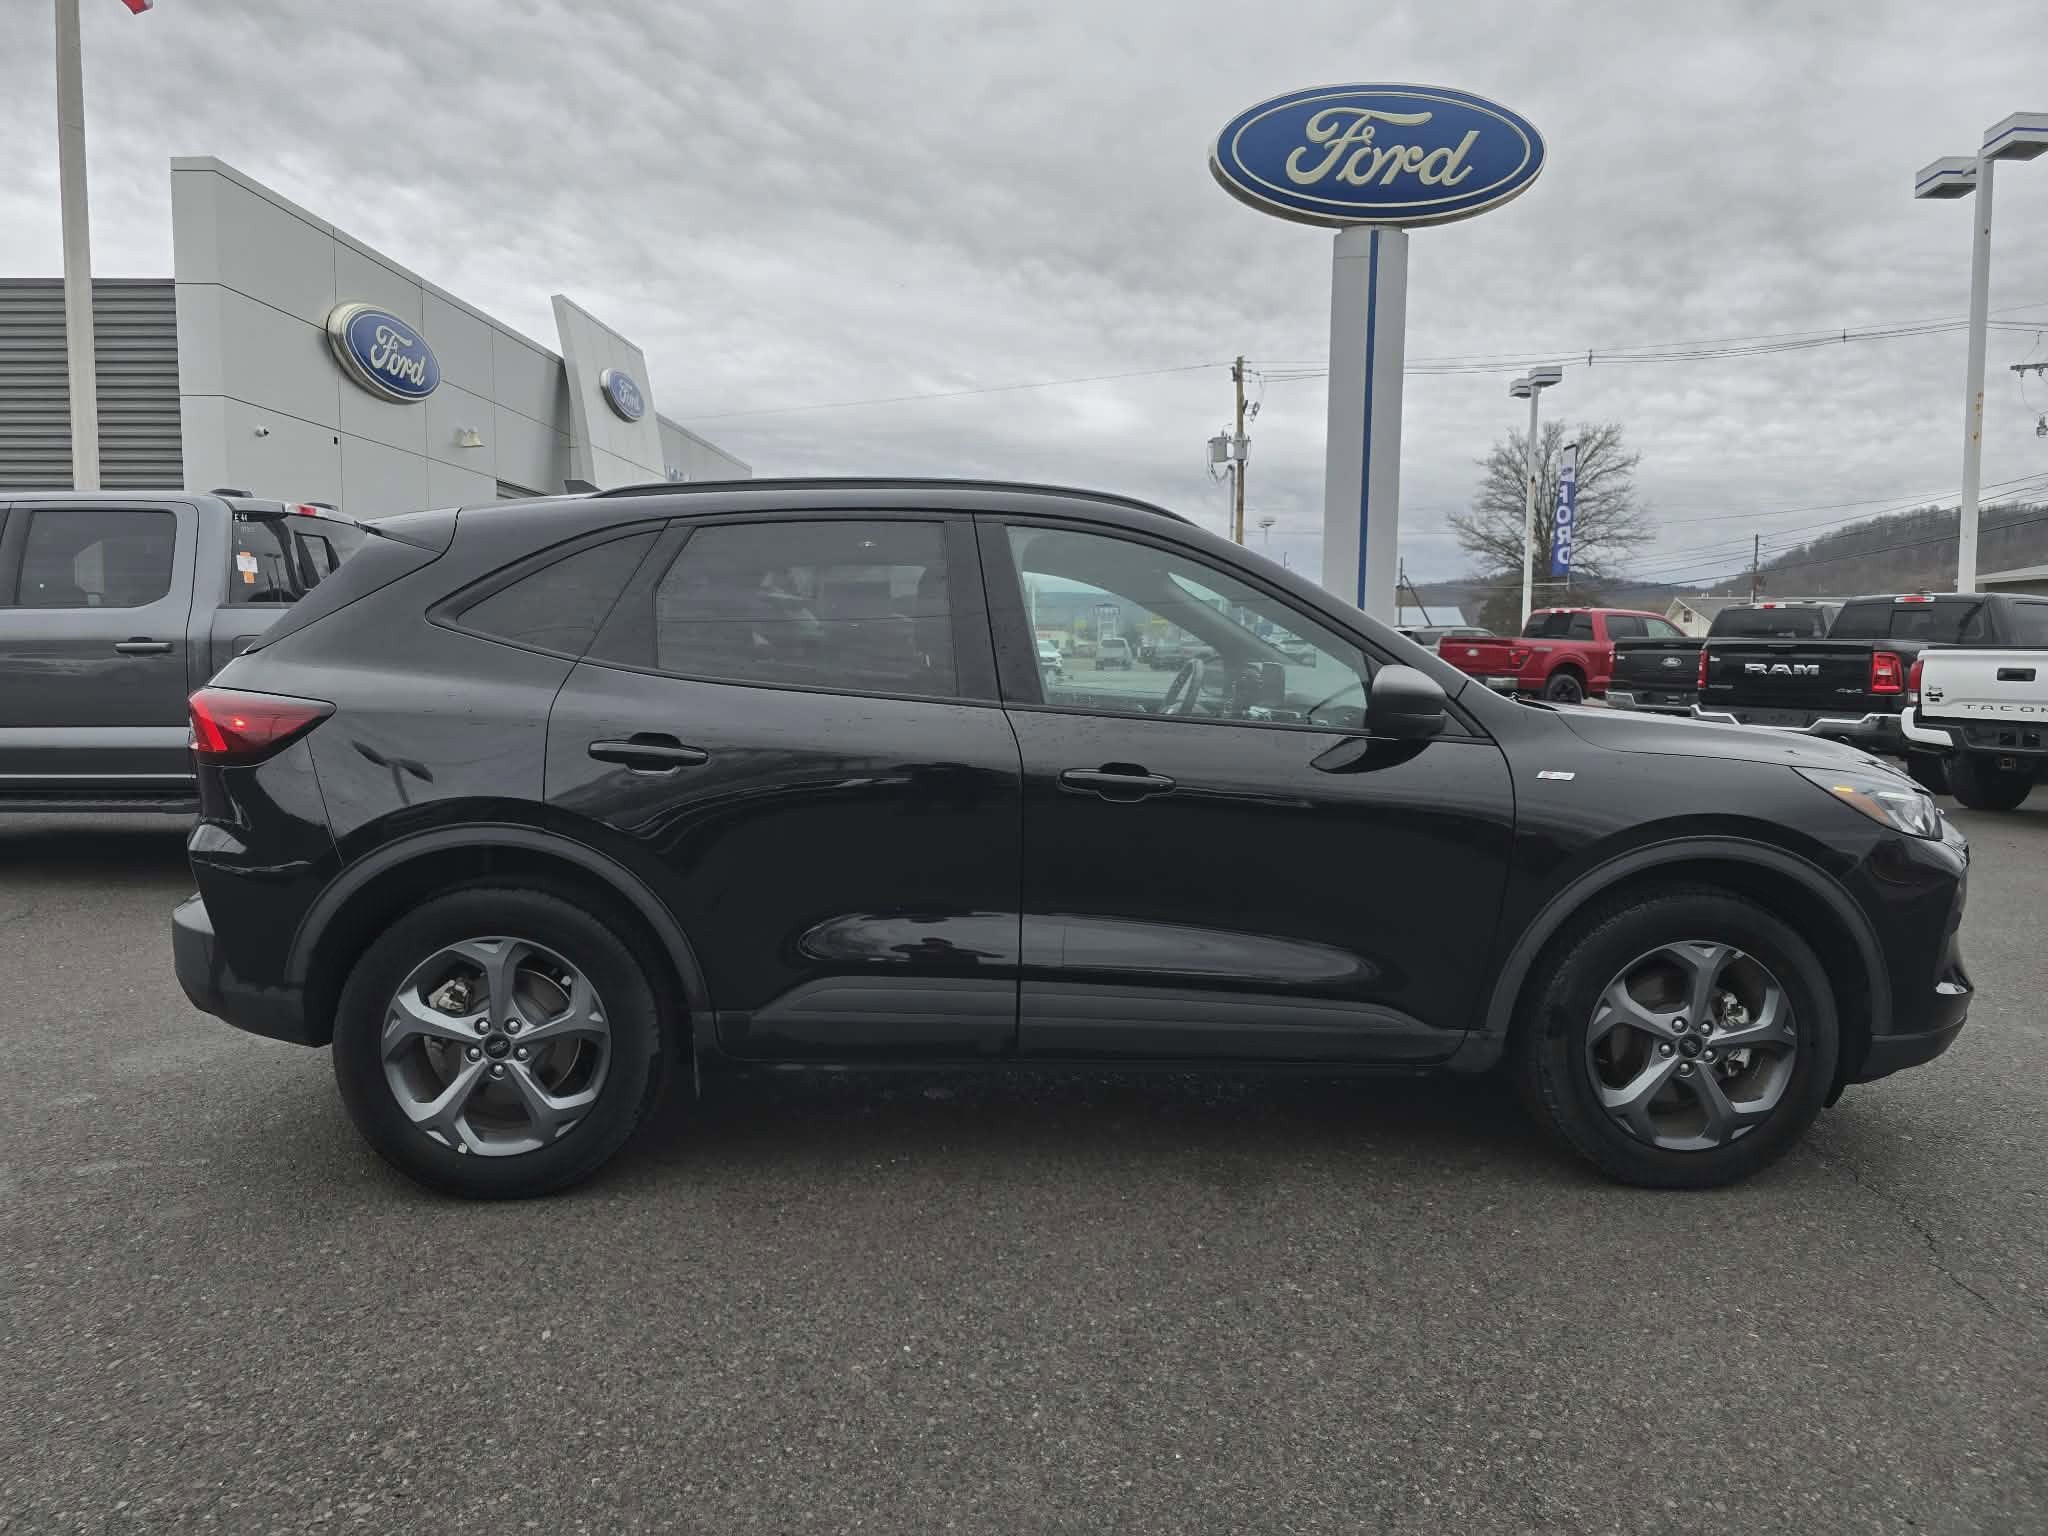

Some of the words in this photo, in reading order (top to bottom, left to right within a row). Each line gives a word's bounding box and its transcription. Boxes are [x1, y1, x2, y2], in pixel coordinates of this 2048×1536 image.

[1285, 106, 1480, 186] Ford
[370, 325, 426, 386] Ford
[1744, 663, 1820, 676] RAM
